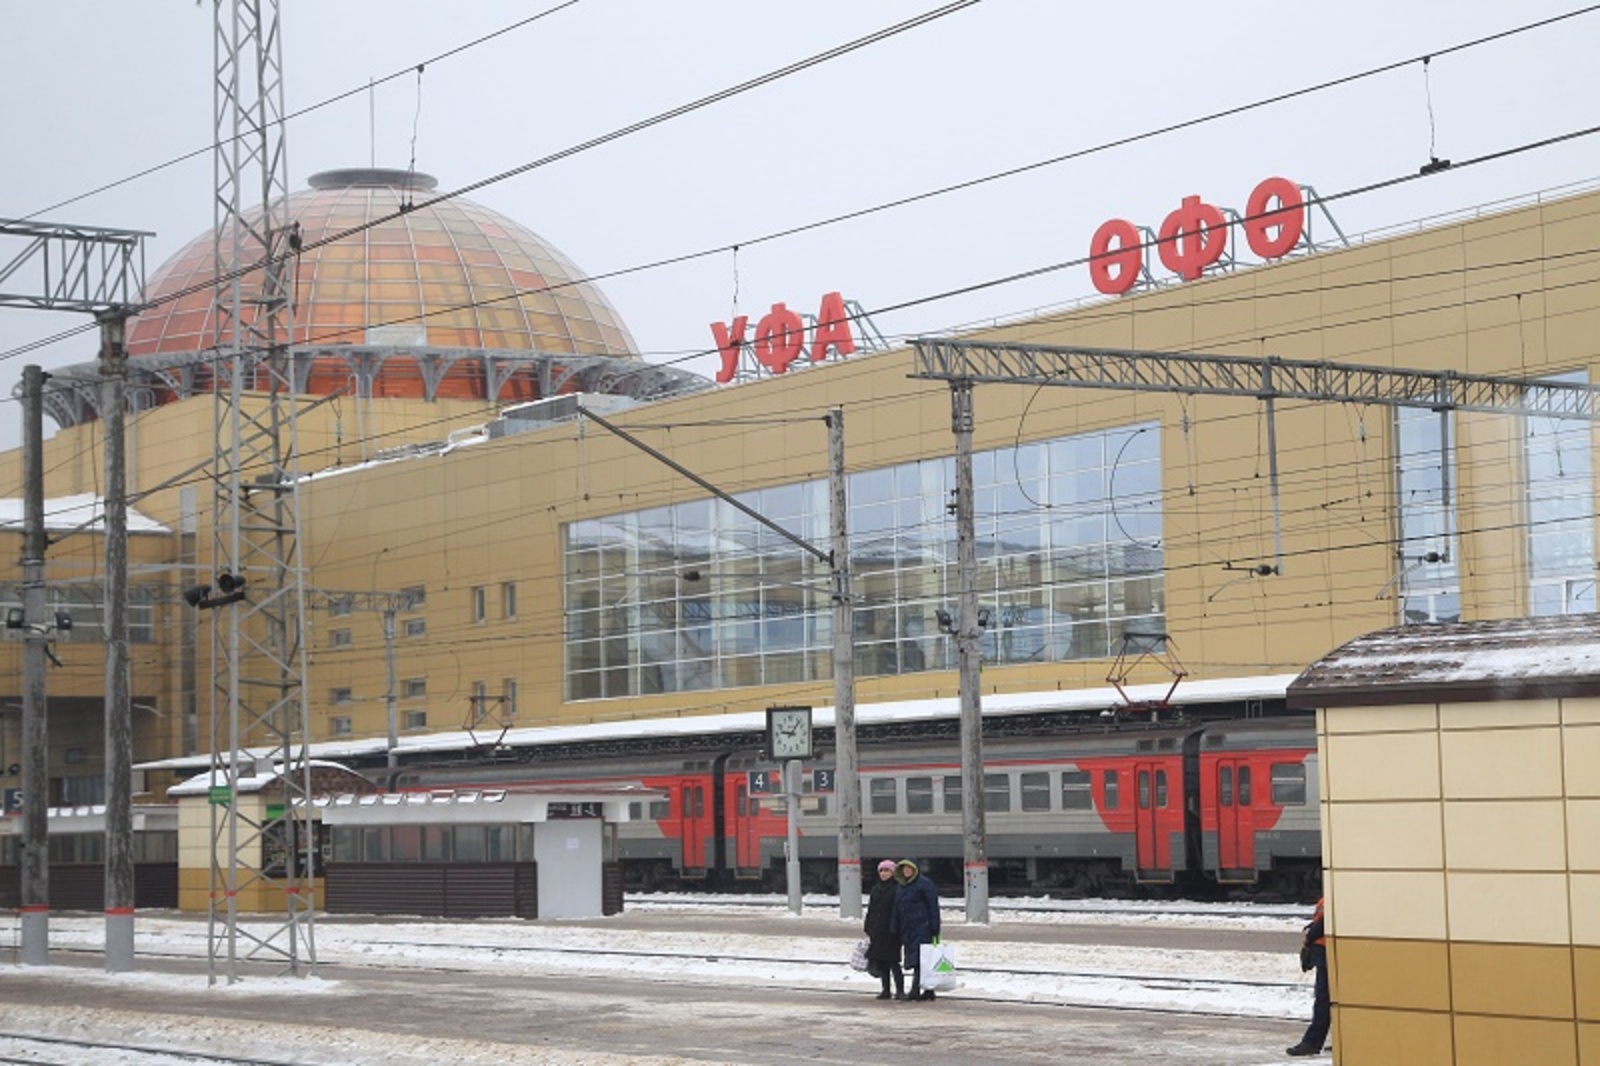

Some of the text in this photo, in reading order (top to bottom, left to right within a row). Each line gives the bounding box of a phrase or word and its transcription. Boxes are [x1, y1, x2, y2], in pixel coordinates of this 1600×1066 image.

[1089, 176, 1304, 294] ӨФӨ
[710, 291, 856, 383] УФА
[754, 773, 764, 788] 4
[819, 771, 829, 787] 3
[12, 791, 24, 808] 5
